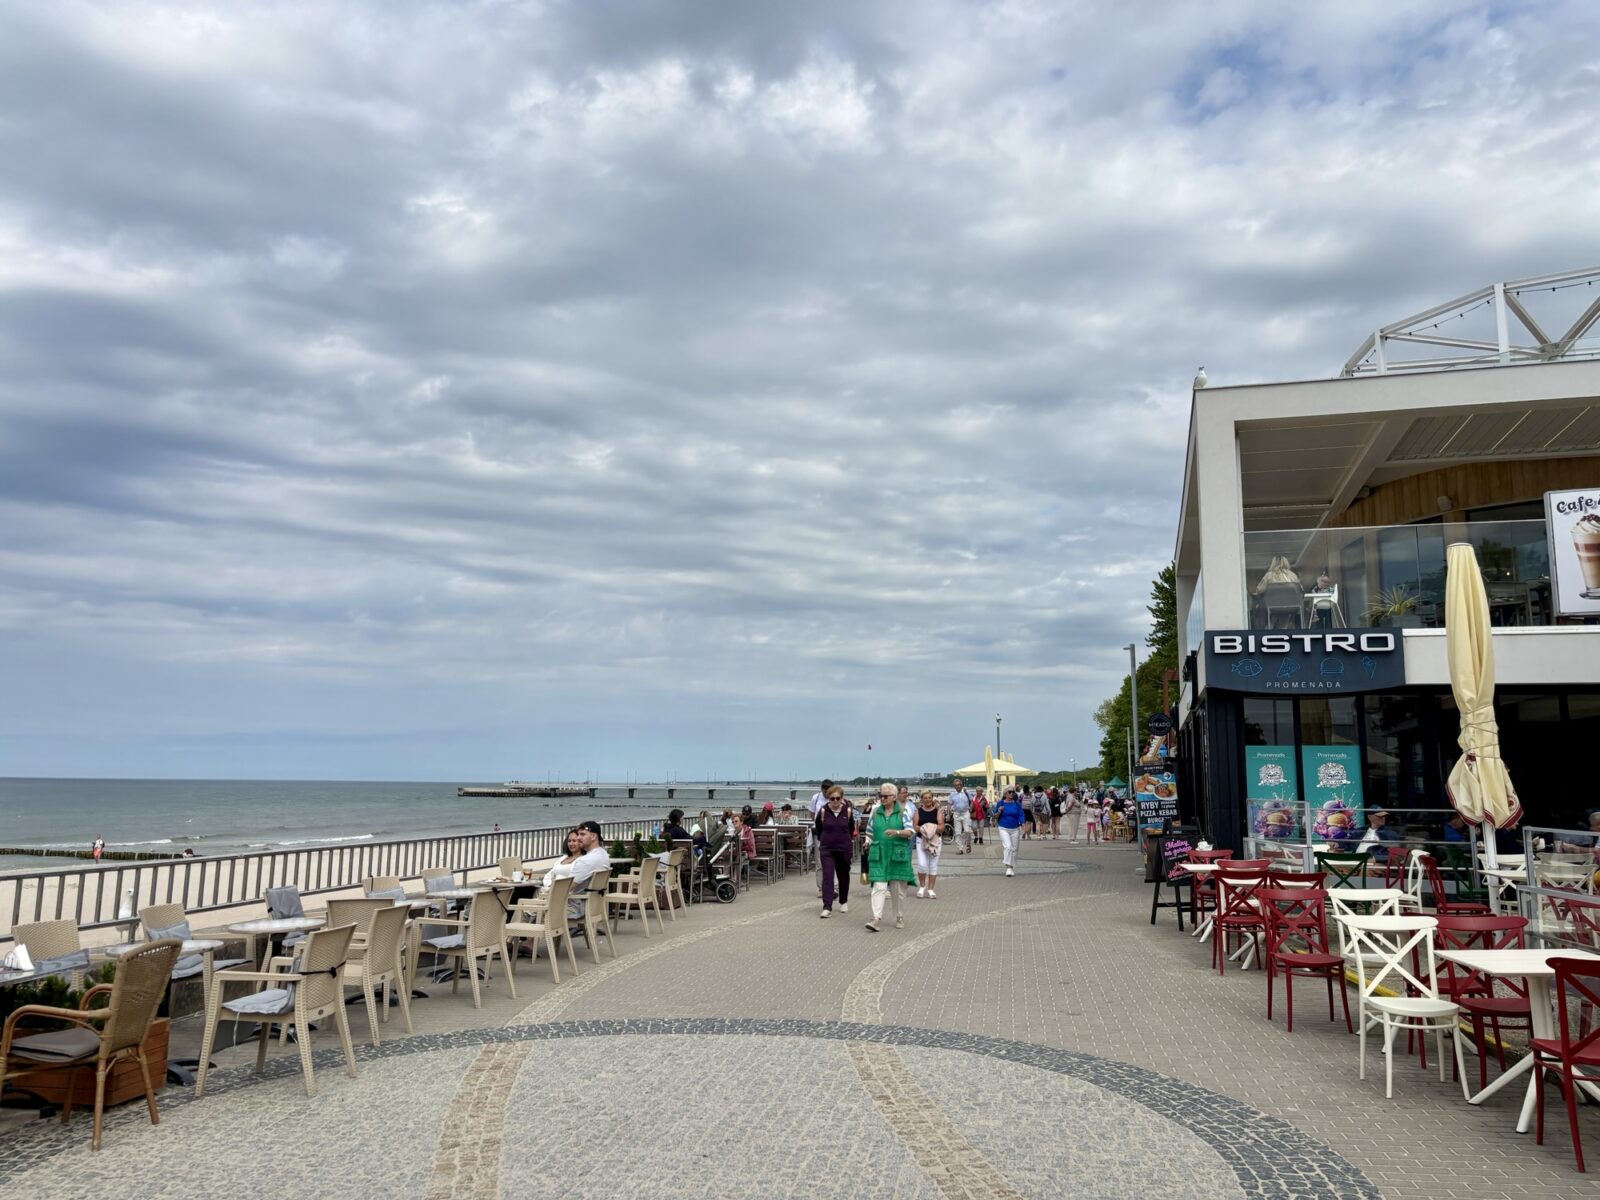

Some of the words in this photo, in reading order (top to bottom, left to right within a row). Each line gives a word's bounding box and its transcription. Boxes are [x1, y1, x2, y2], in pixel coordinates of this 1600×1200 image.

[1556, 496, 1593, 513] Cafe
[1213, 633, 1395, 654] BISTRO
[1140, 801, 1159, 810] RYBY
